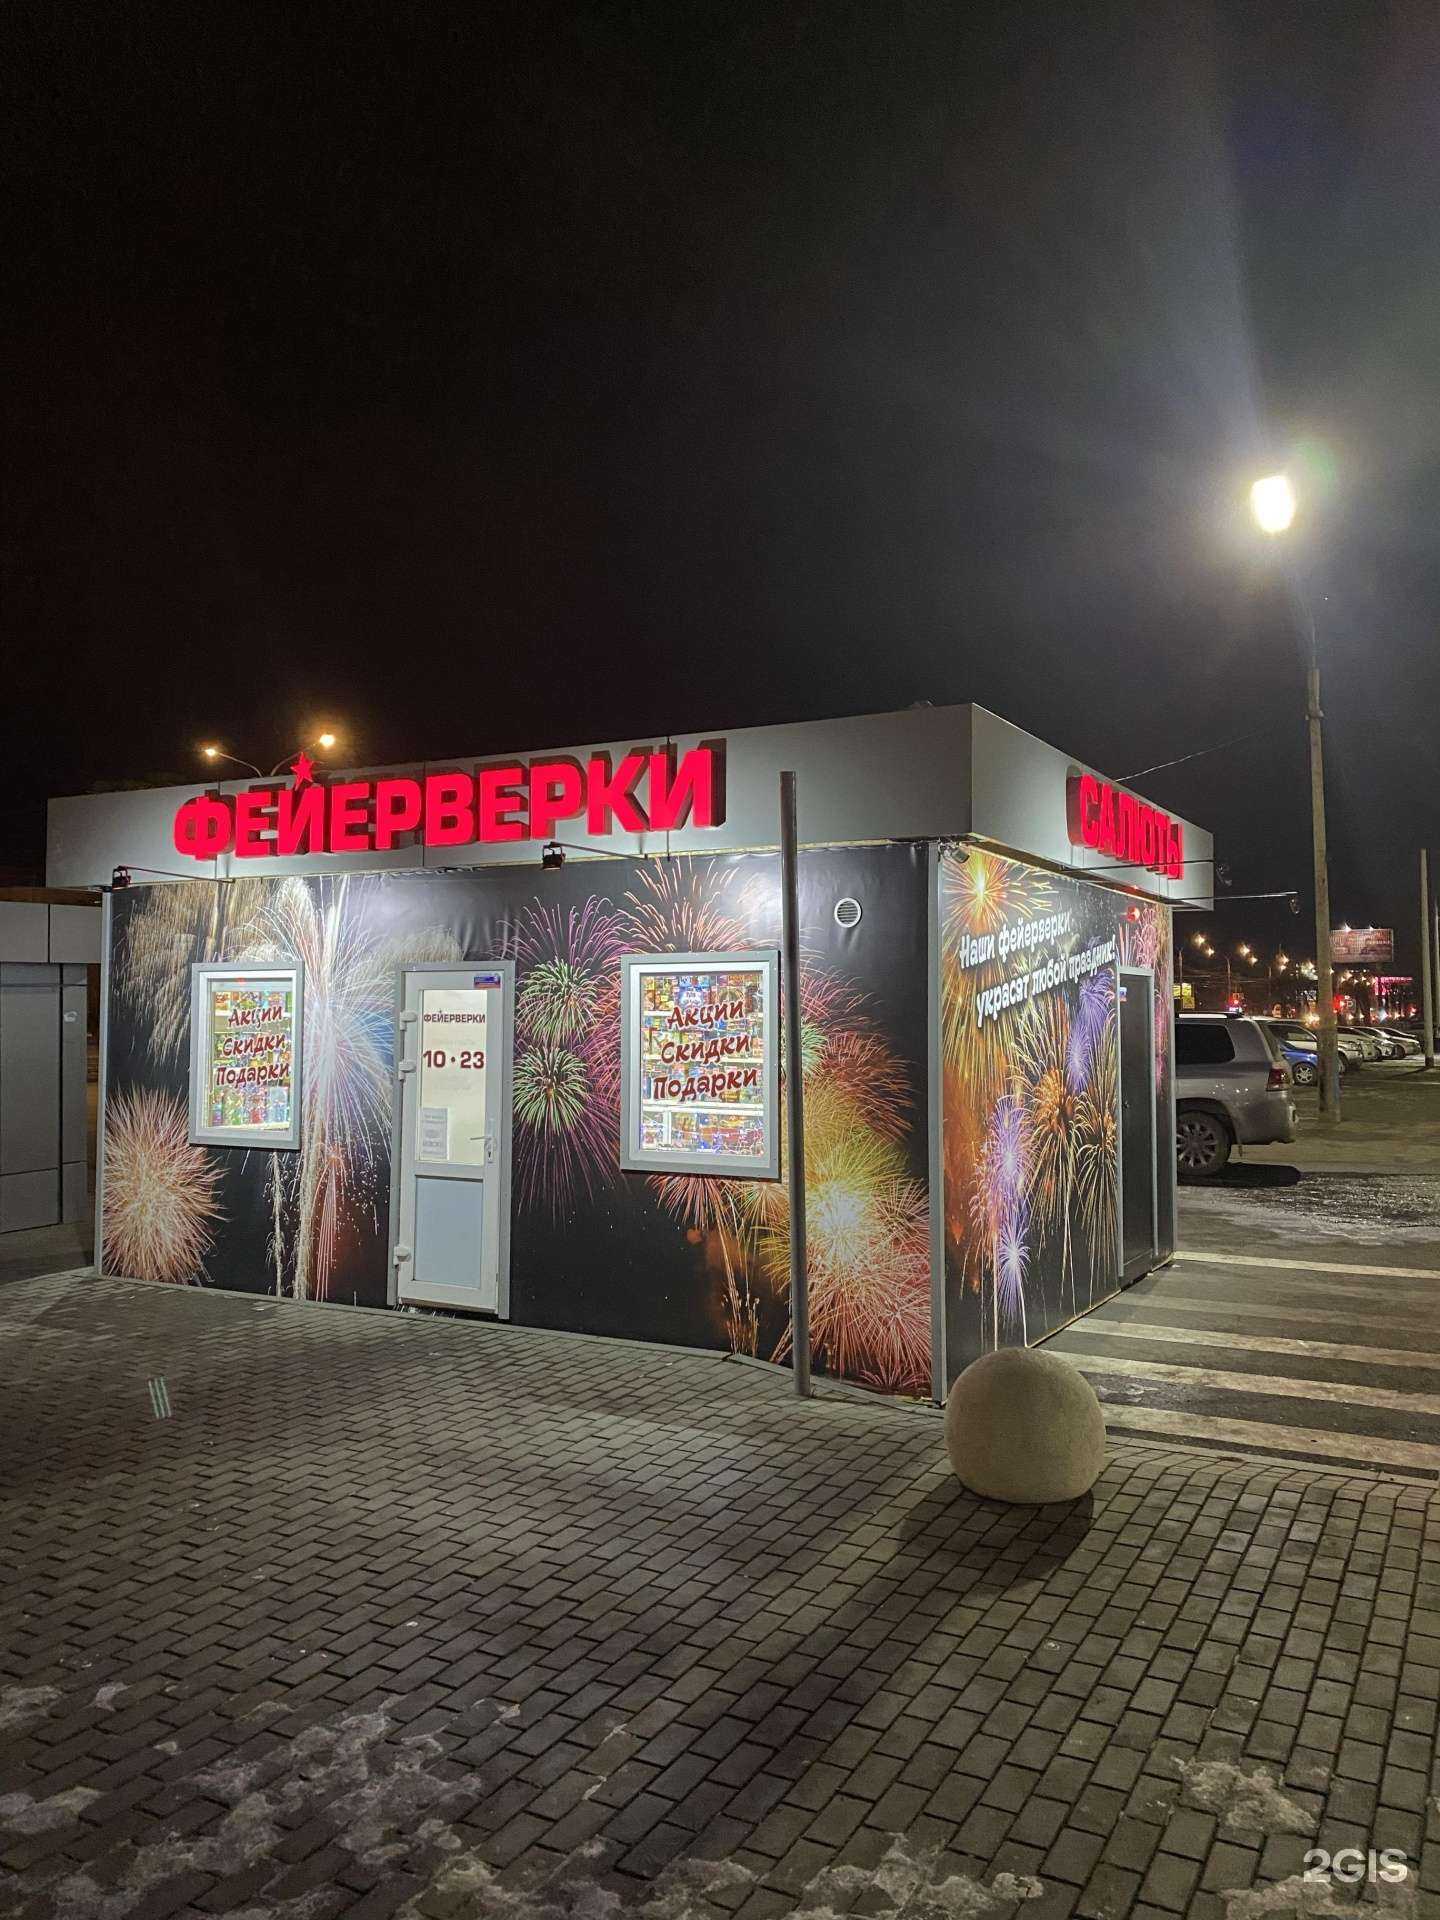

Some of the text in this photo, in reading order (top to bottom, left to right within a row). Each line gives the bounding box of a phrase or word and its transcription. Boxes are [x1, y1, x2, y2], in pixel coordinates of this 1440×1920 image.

[174, 749, 713, 860] ФЕЙЕРВЕРКИ
[1080, 773, 1184, 880] САЛЮТЫ
[959, 909, 1071, 969] Наши фейерверки
[976, 934, 1116, 1028] украсят любой праздник!
[228, 1005, 284, 1028] Акции
[423, 1009, 486, 1023] ФЕЙЕРВЕРКИ
[667, 1000, 744, 1029] Акции
[222, 1034, 286, 1057] Скидки
[660, 1035, 750, 1065] Скидки
[216, 1062, 290, 1088] Подарки
[653, 1068, 758, 1102] Подарки
